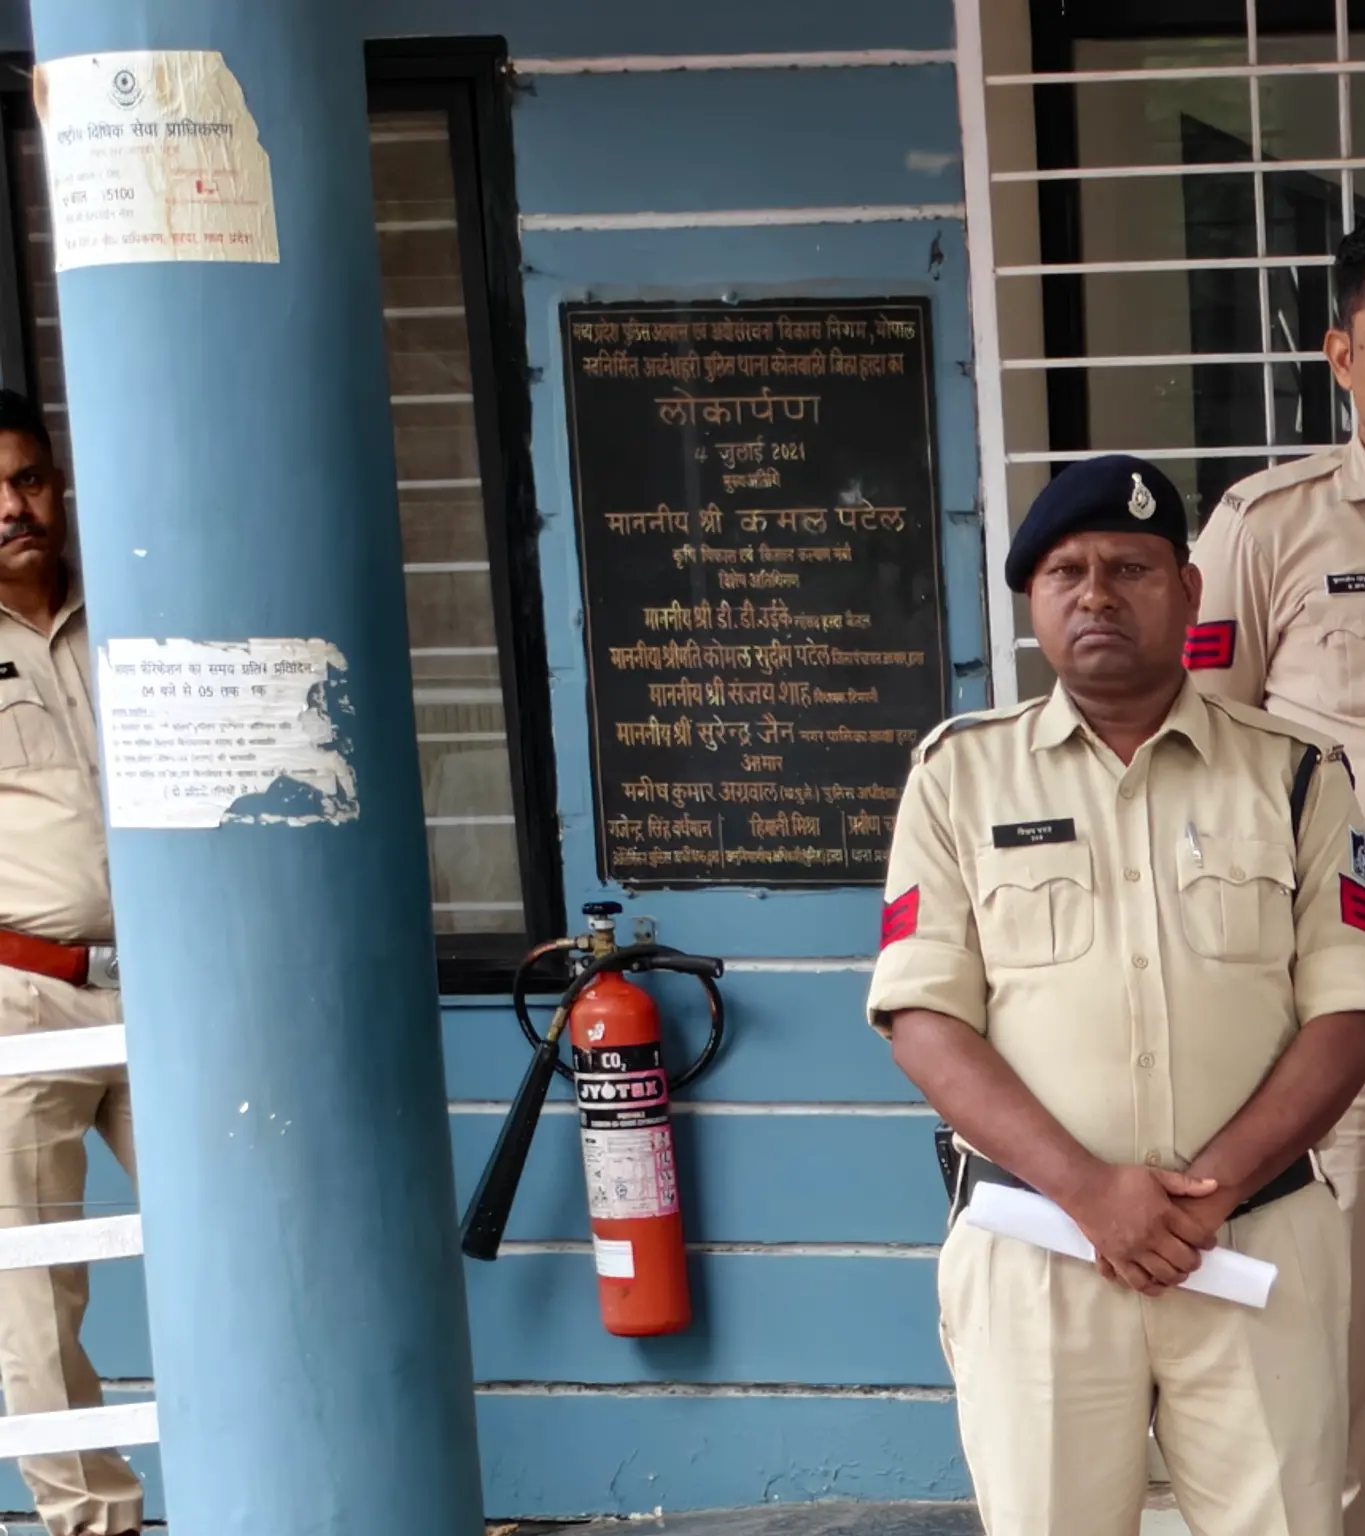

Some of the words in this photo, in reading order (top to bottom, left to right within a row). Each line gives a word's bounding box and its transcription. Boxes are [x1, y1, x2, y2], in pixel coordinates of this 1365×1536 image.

[165, 117, 234, 140] प्राधिकरण
[653, 385, 822, 427] लोकार्पण
[714, 434, 766, 470] जुलाई
[771, 441, 806, 461] 2021
[604, 502, 688, 535] माननीय
[698, 501, 724, 534] श्री
[833, 498, 907, 533] पटेल
[643, 598, 693, 632] माननीय
[693, 598, 713, 630] श्री
[198, 685, 214, 698] 05
[647, 675, 704, 708] माननीय
[705, 674, 726, 707] श्री
[778, 680, 812, 710] शाह
[615, 714, 673, 747] माननीय
[673, 714, 693, 747] श्री
[621, 774, 669, 803] मनीष
[671, 781, 718, 809] कुमार
[718, 780, 778, 803] अग्रवाल
